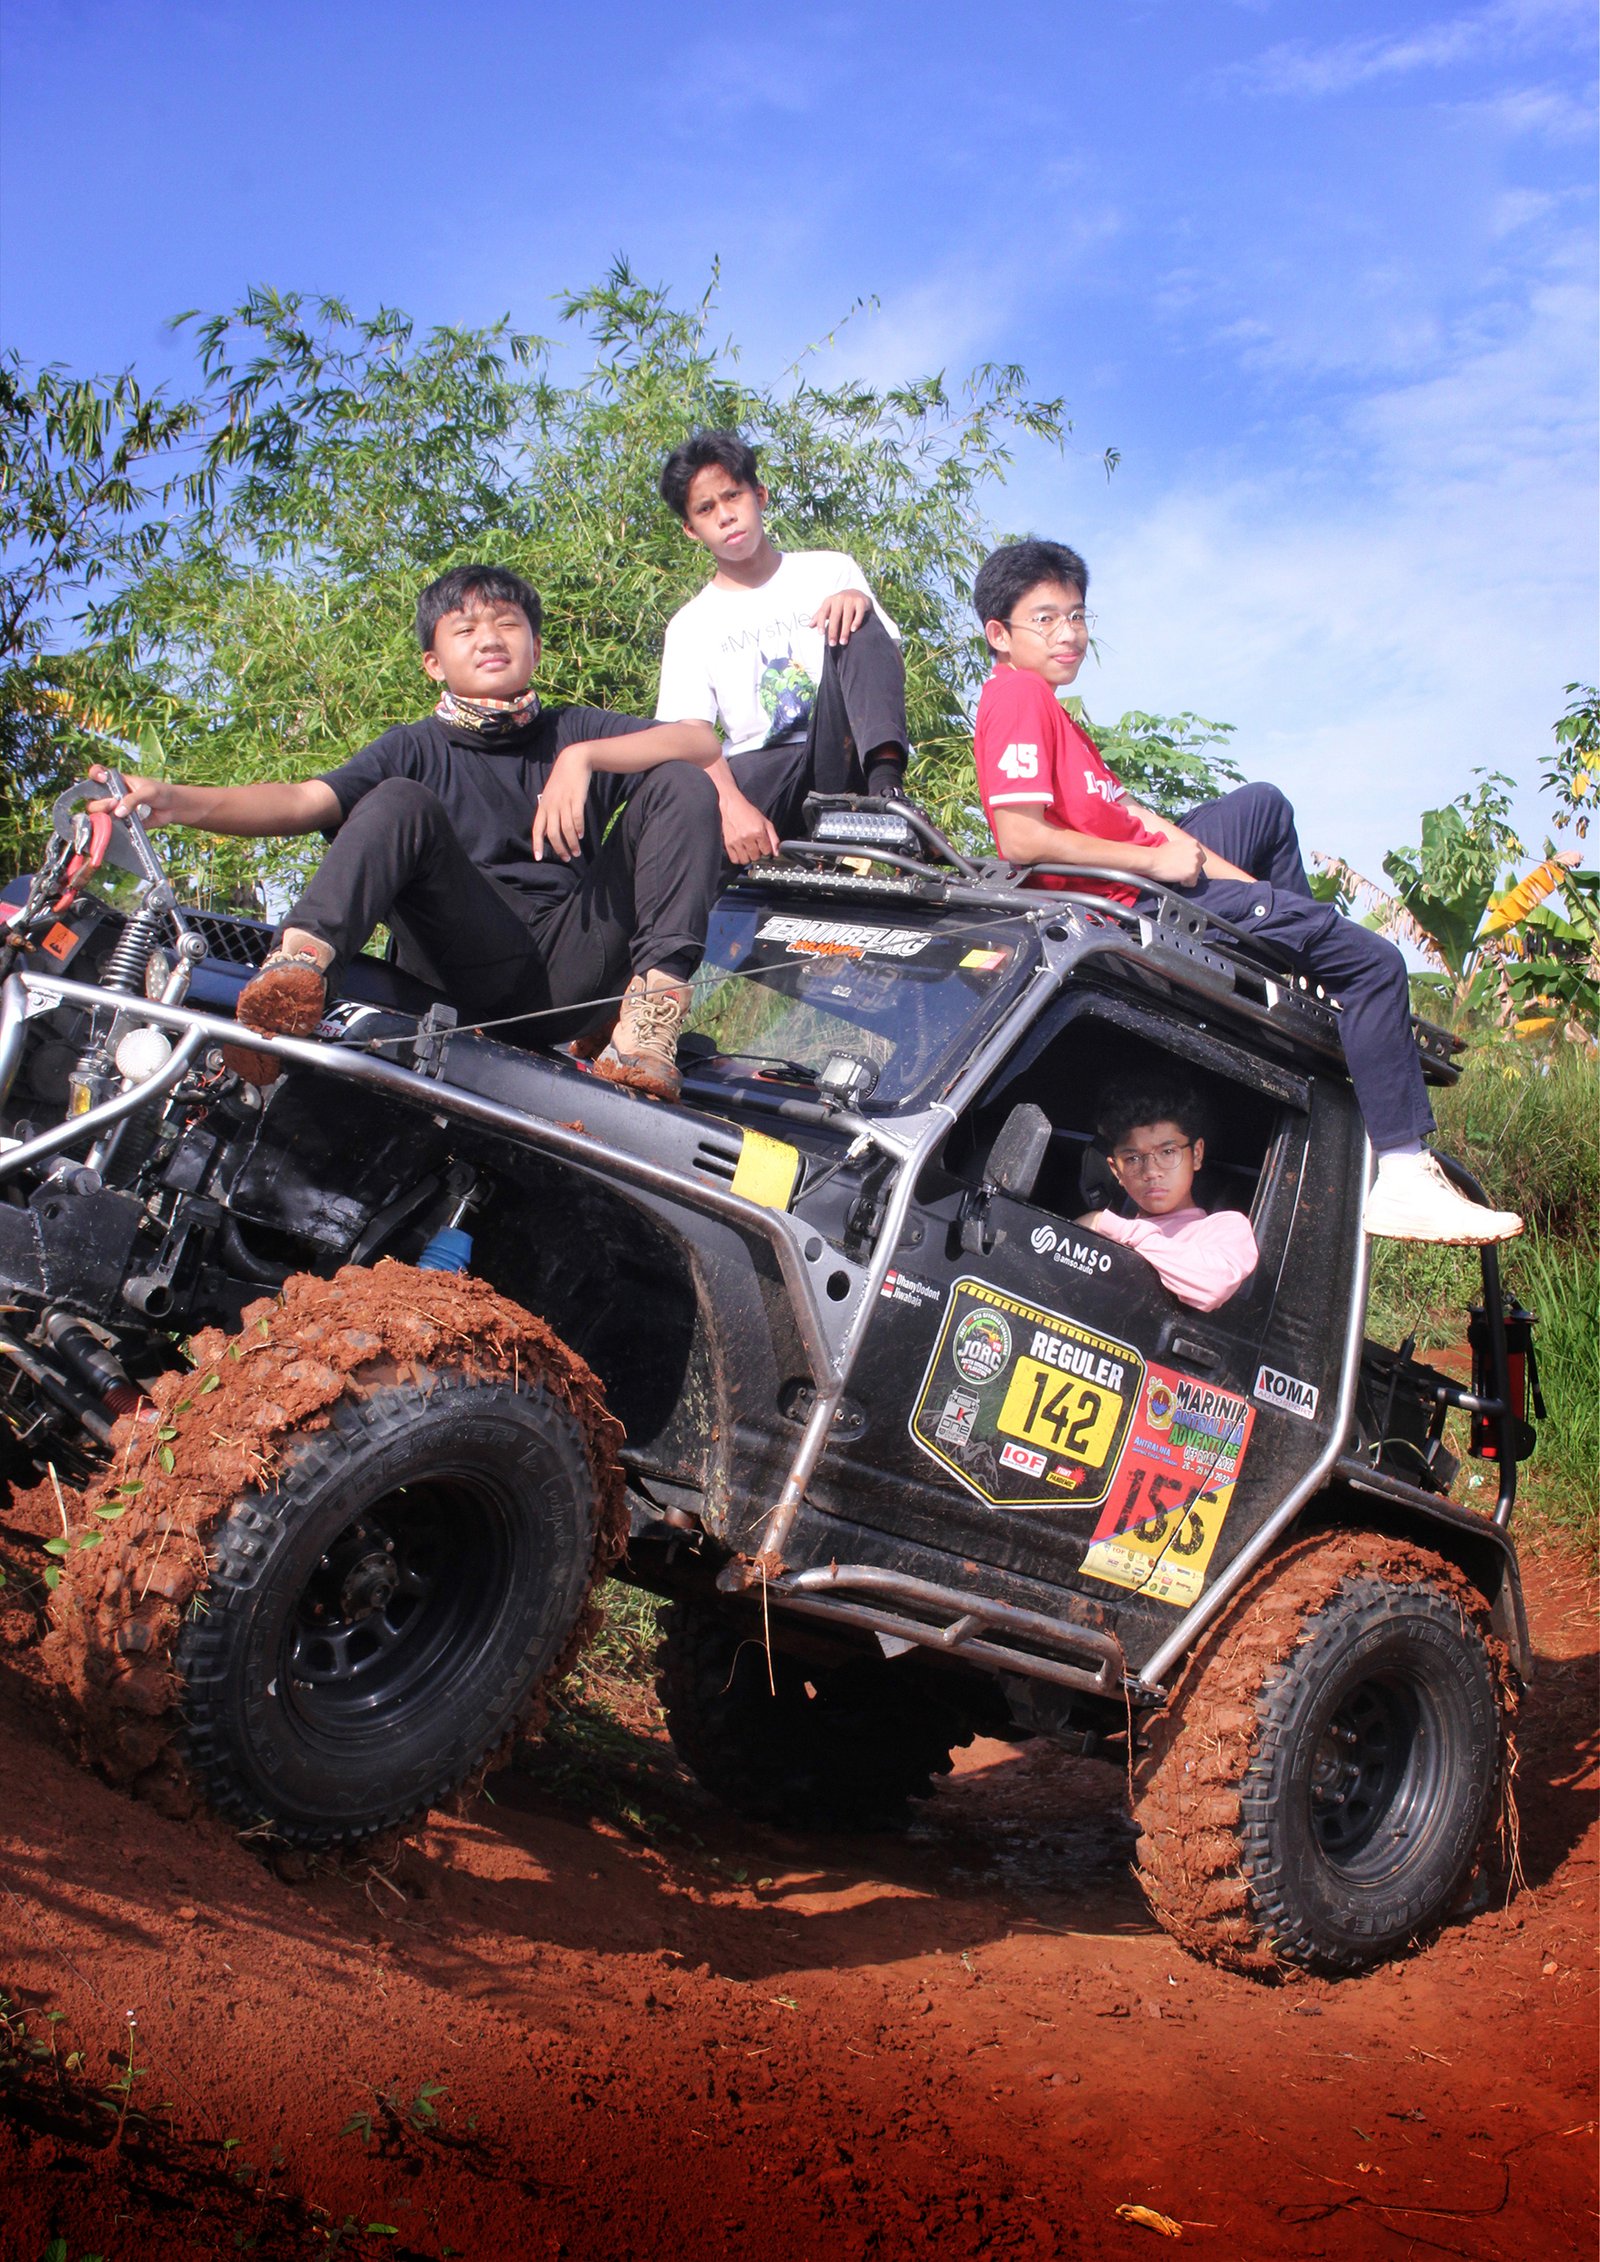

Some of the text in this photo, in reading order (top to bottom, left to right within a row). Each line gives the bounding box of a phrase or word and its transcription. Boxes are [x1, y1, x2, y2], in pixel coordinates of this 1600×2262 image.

[998, 743, 1039, 779] 45
[1055, 1237, 1112, 1273] AMSO
[1030, 1330, 1125, 1392] REGULER
[1176, 1379, 1249, 1424] MARINIR
[1257, 1390, 1313, 1416] AUTOSPORT
[1259, 1369, 1314, 1410] ROMA
[1022, 1372, 1102, 1455] 142
[1171, 1408, 1245, 1447] ANTRALINA
[1002, 1446, 1045, 1469] IOF
[1168, 1422, 1241, 1459] ADVENTURE
[1183, 1446, 1198, 1462] OFF
[1217, 1455, 1236, 1472] 2022
[1048, 1474, 1076, 1488] PANDEMIC
[1113, 1468, 1218, 1556] 155
